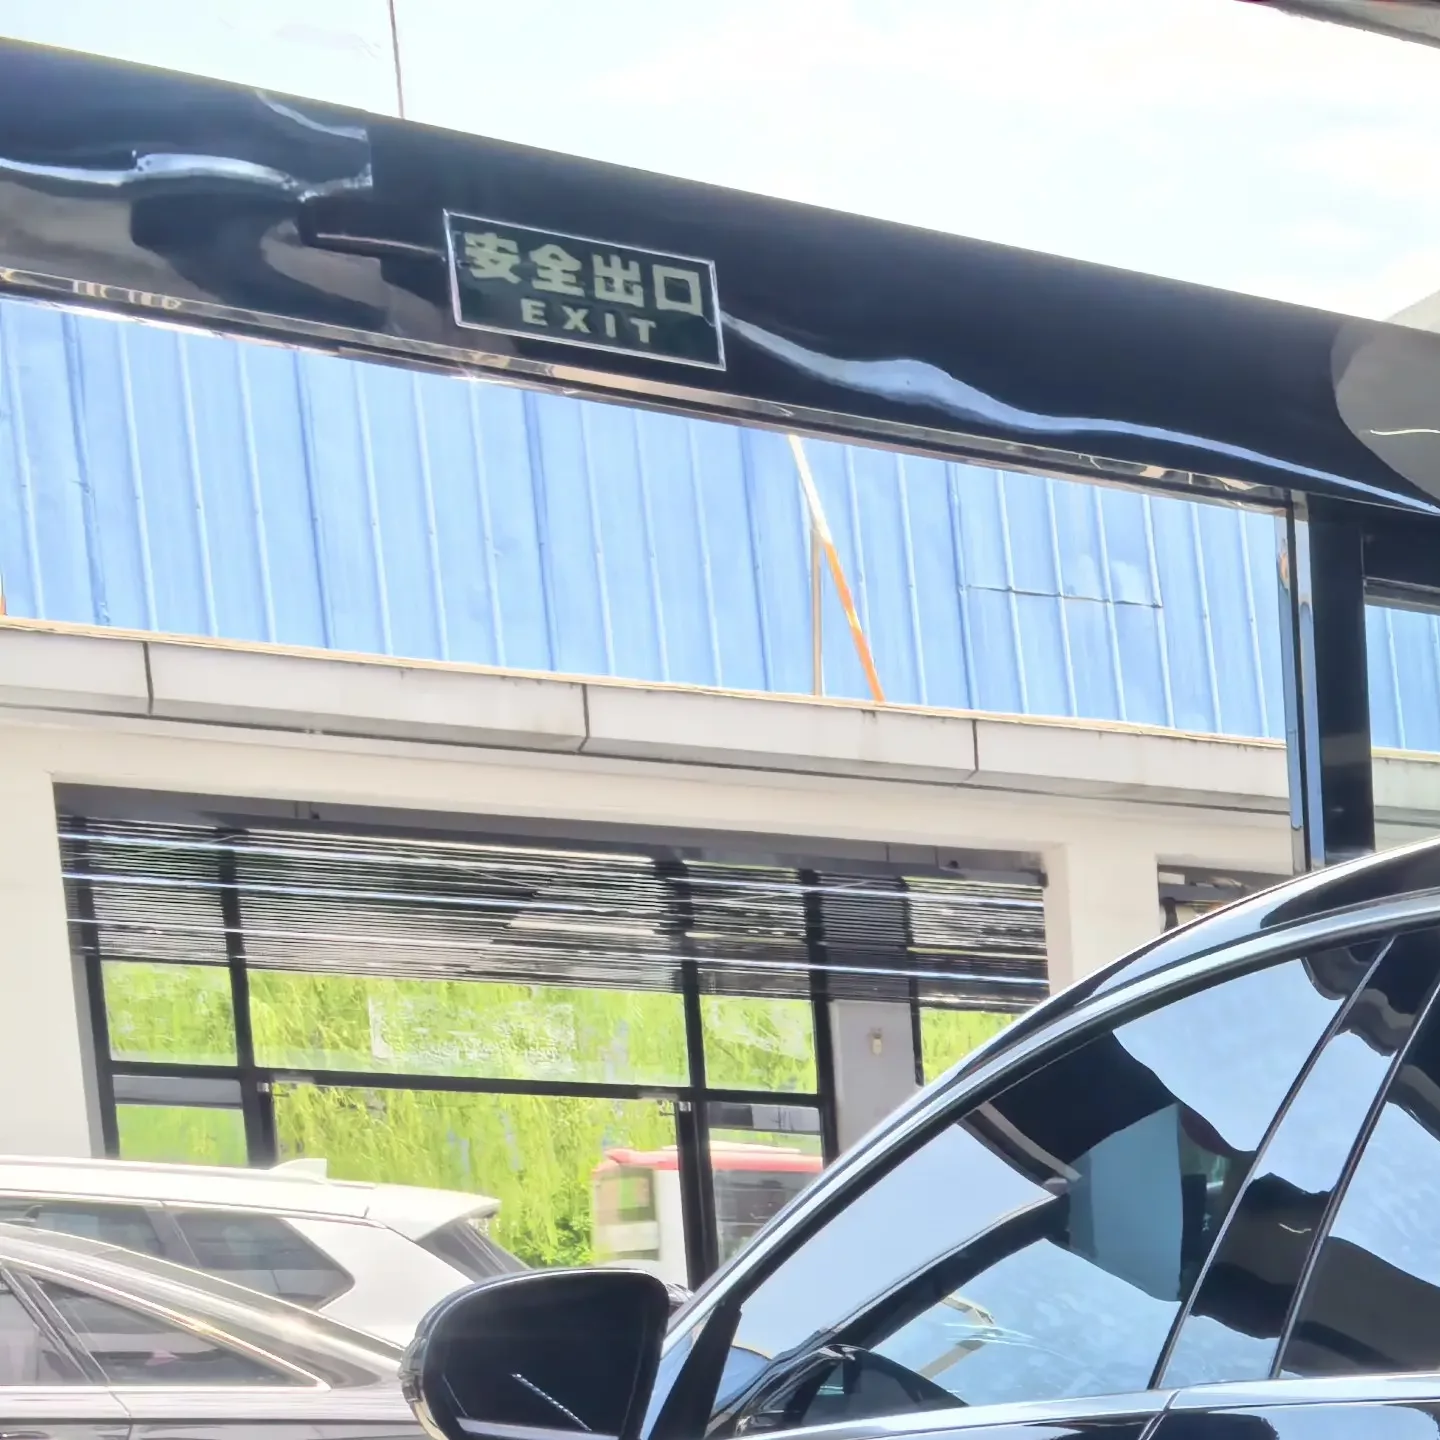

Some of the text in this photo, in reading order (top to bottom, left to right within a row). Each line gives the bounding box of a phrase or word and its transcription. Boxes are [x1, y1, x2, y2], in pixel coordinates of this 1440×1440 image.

[462, 230, 704, 317] 安全出口
[520, 299, 658, 345] EXIT
